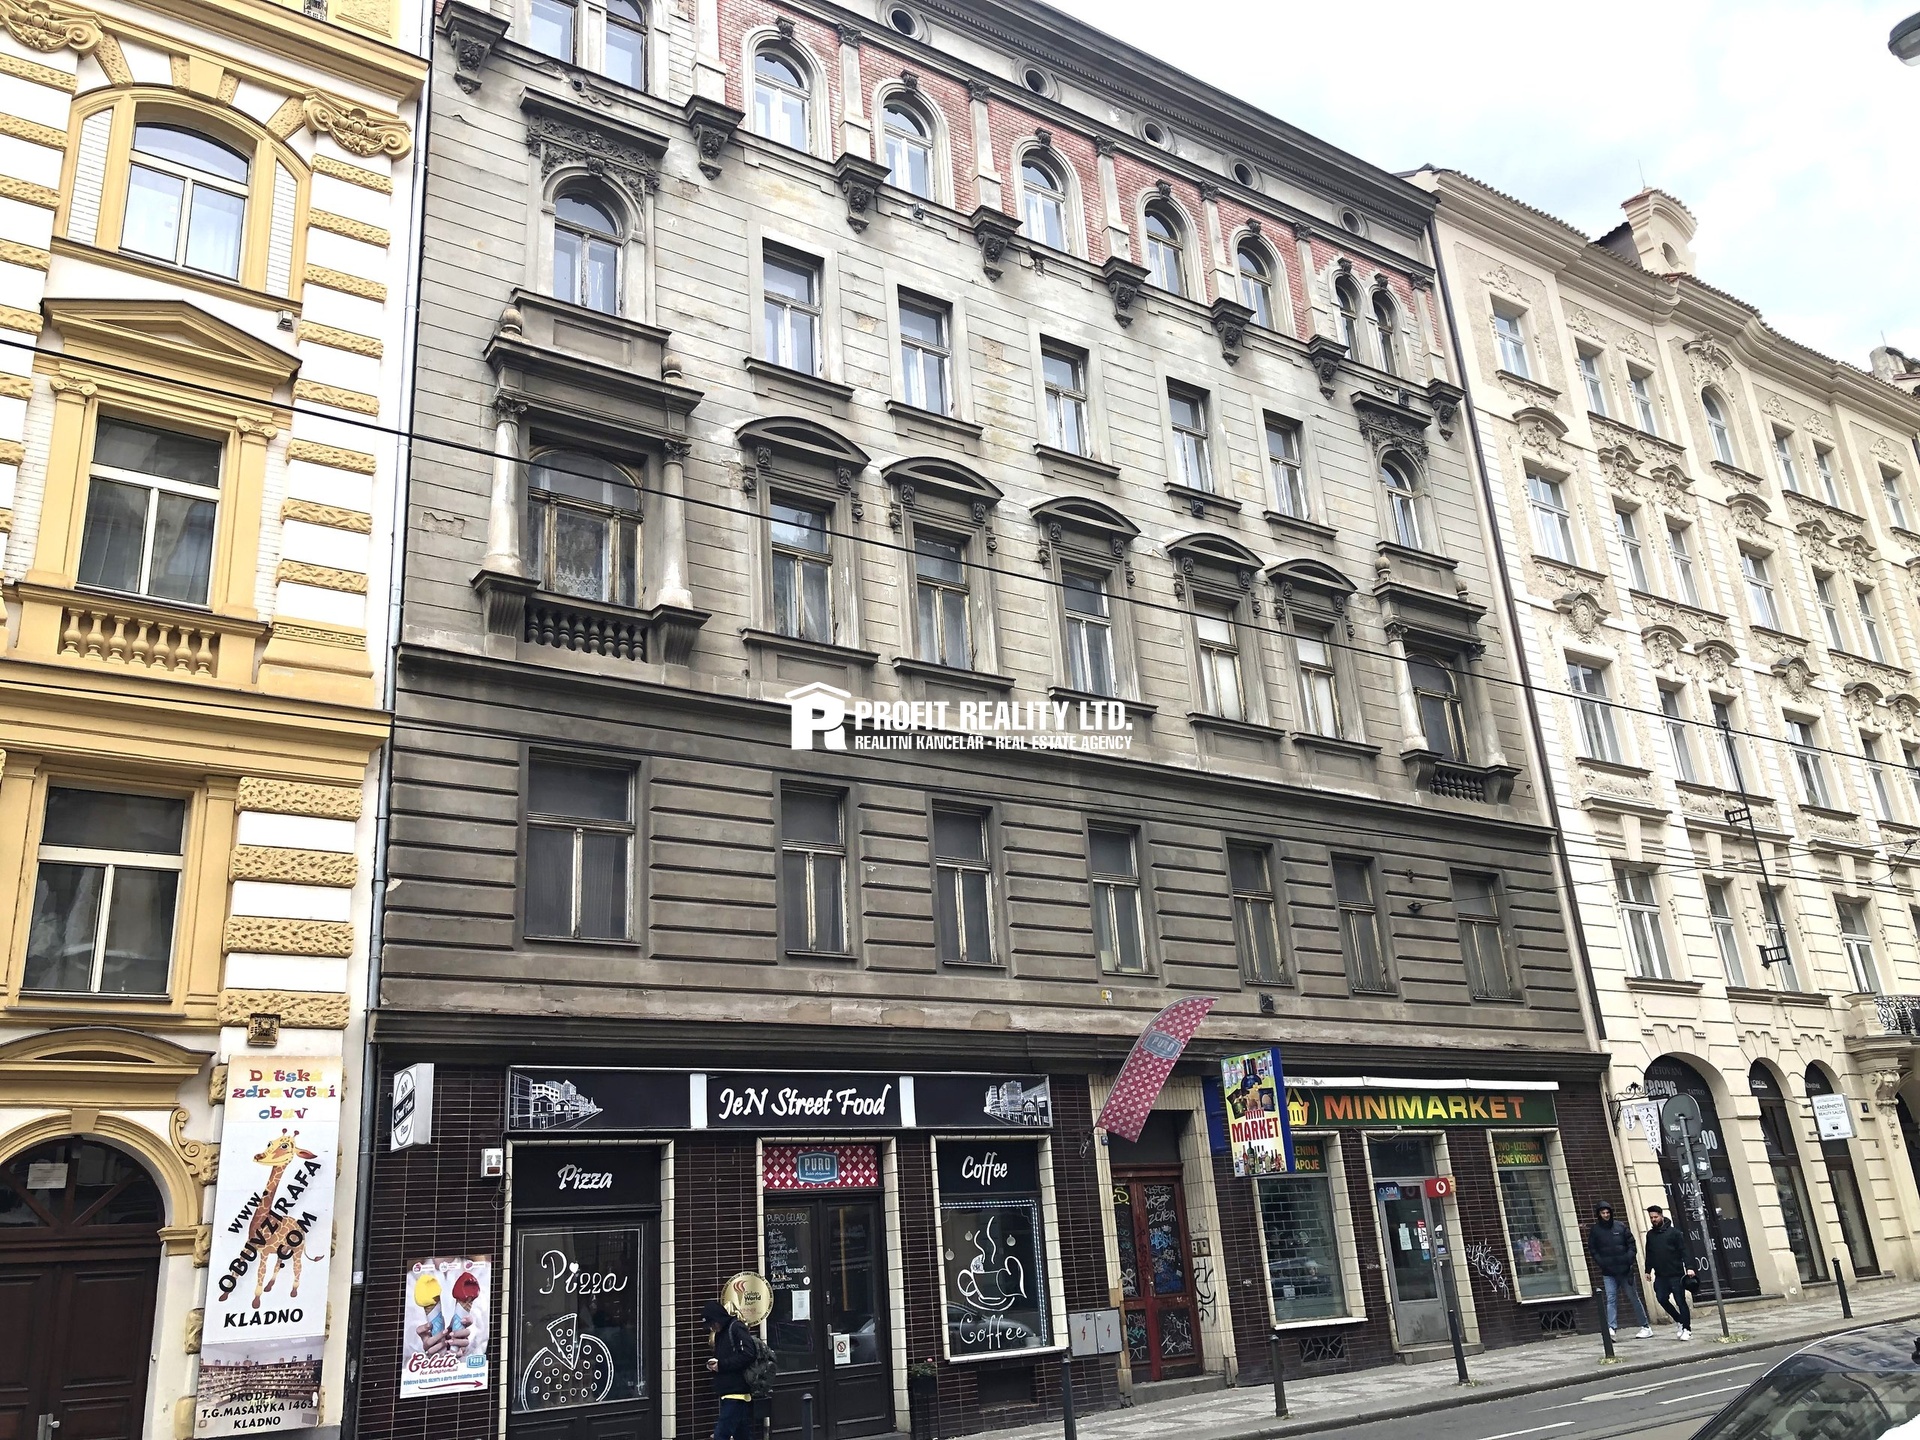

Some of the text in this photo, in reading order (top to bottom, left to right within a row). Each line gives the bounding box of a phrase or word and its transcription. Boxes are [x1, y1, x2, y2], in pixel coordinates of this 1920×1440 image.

[232, 1085, 336, 1098] zdravotní
[771, 1089, 833, 1118] Street
[836, 1084, 891, 1117] Food
[259, 1106, 308, 1119] obuv
[1323, 1095, 1525, 1120] MINIMARKET
[1231, 1117, 1279, 1143] MARKET
[804, 1157, 831, 1171] PURO
[962, 1152, 1008, 1186] Coffee
[558, 1164, 612, 1190] Pizza
[1385, 1185, 1398, 1195] SIM
[218, 1160, 321, 1293] OBUVZIRAFA
[539, 1250, 628, 1295] Pizza
[223, 1308, 304, 1328] KLADNO
[959, 1313, 1027, 1350] Coffee
[408, 1352, 459, 1373] Gelato
[202, 1402, 285, 1419] T.G.MASARYKA
[233, 1416, 281, 1429] KLADNO
